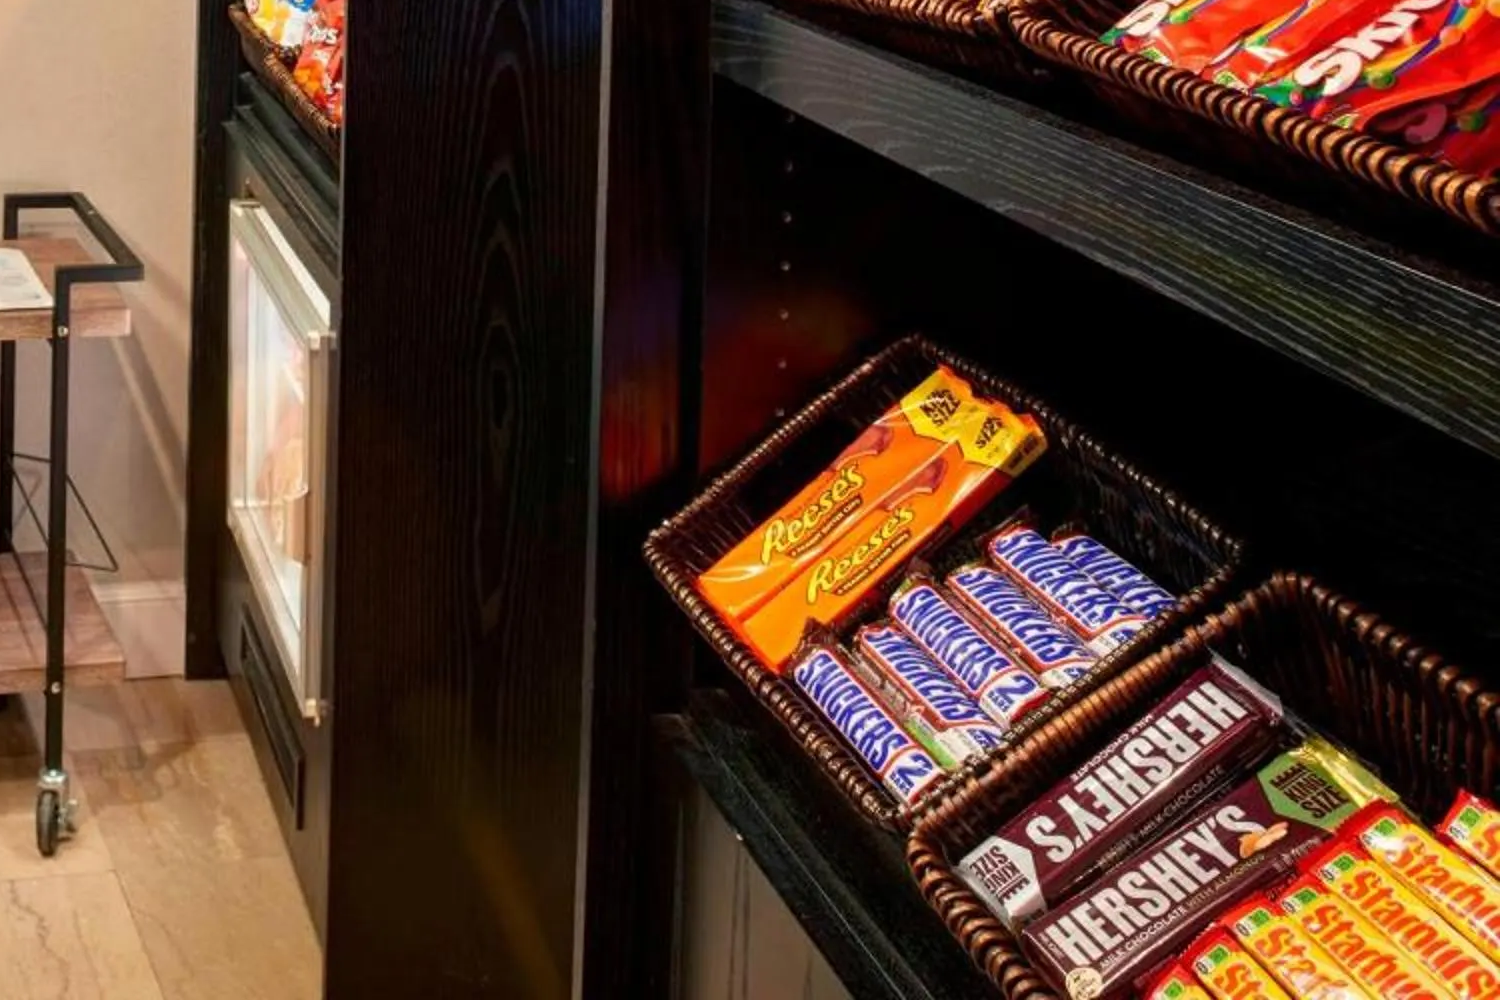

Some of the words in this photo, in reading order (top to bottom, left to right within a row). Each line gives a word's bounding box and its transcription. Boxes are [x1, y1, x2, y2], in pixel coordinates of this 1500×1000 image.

[955, 569, 1093, 663] SNICKERS
[995, 532, 1138, 626] SNICKERS
[863, 629, 992, 721] SNICKERS
[896, 588, 1013, 691] SNICKERS
[796, 653, 912, 771] SNICKERS
[994, 674, 1037, 706] 2
[895, 753, 934, 789] 2
[1025, 681, 1249, 864] HERSHEY'S
[1284, 775, 1327, 803] KING
[1300, 785, 1350, 818] SIZE
[969, 845, 1009, 880] SIZE
[984, 863, 1021, 895] KING
[1044, 805, 1267, 967] HERSHEY'S
[1125, 908, 1188, 952] CHOCOLATE
[1341, 869, 1500, 1000] Starburs
